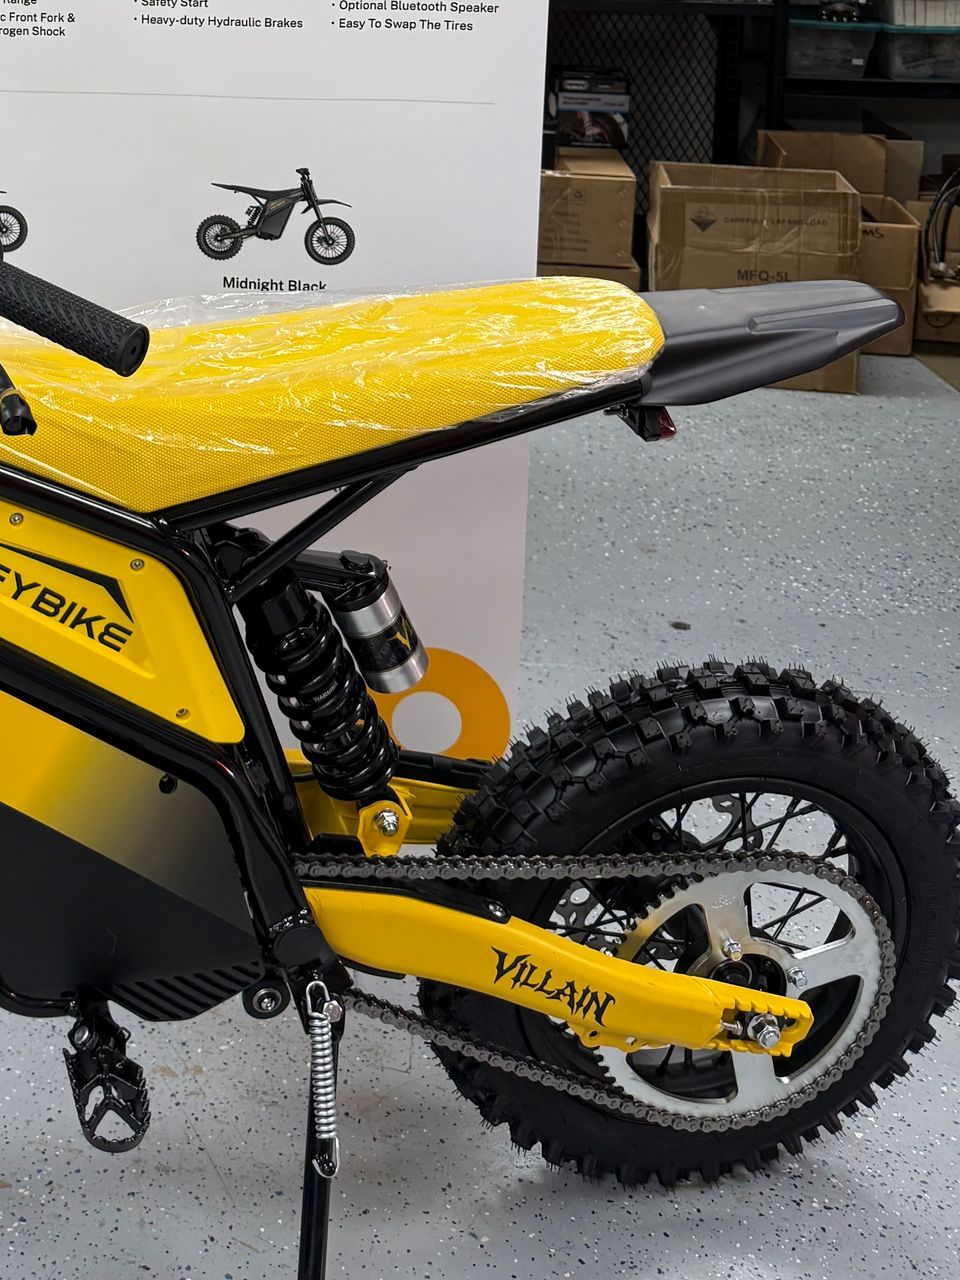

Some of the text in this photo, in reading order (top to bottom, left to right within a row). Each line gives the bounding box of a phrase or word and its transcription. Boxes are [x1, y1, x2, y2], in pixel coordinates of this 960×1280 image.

[339, 0, 500, 15] Optional Bluetooth Speaker
[9, 12, 38, 23] Front
[40, 12, 65, 23] Fork
[67, 12, 76, 23] &
[141, 14, 303, 31] Heavy-duty Hydraulic Brakes
[339, 18, 473, 32] Easy To Swap The Tires
[31, 26, 66, 37] Shock
[223, 276, 327, 292] Midnight Black
[491, 946, 616, 1026] VILLAIN
